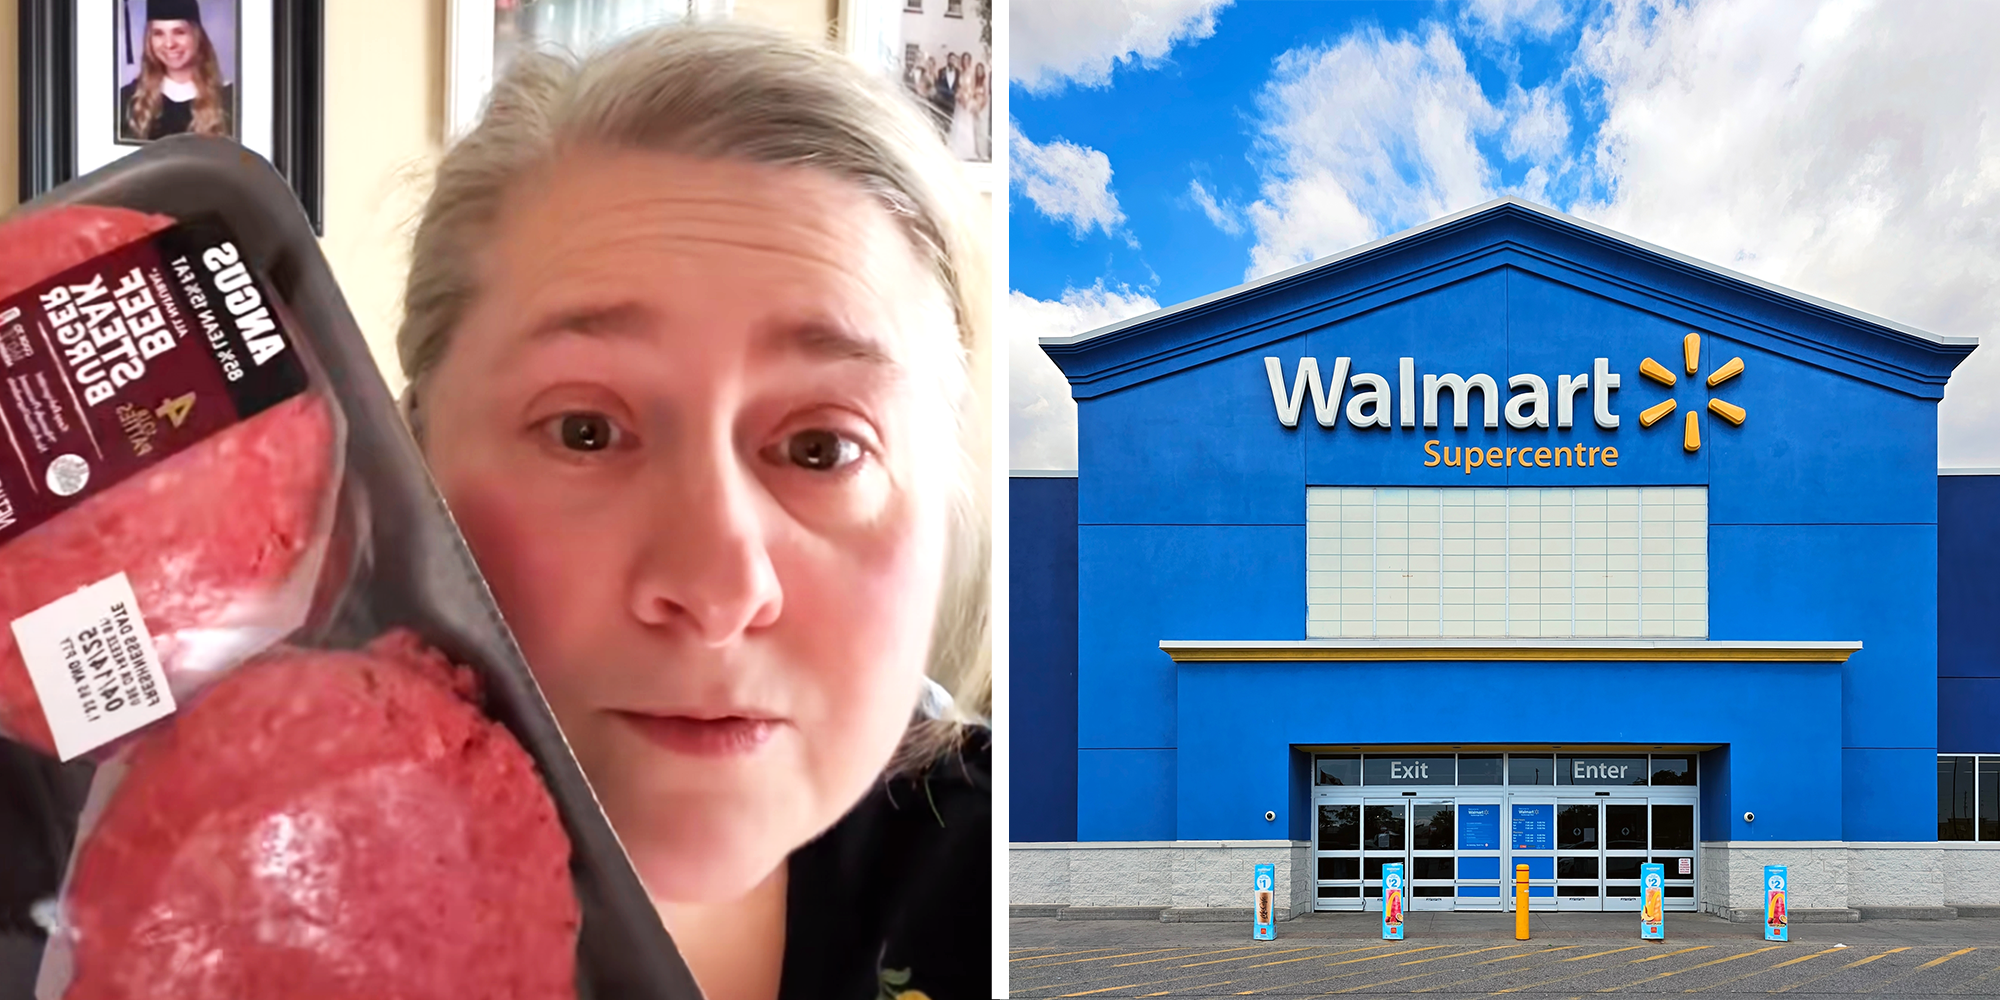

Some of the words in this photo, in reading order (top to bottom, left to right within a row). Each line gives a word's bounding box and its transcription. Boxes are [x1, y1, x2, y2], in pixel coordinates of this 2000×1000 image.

[1263, 356, 1620, 429] Walmart
[1423, 439, 1619, 474] Supercentre
[1390, 761, 1429, 779] Exit
[1573, 761, 1628, 779] Enter
